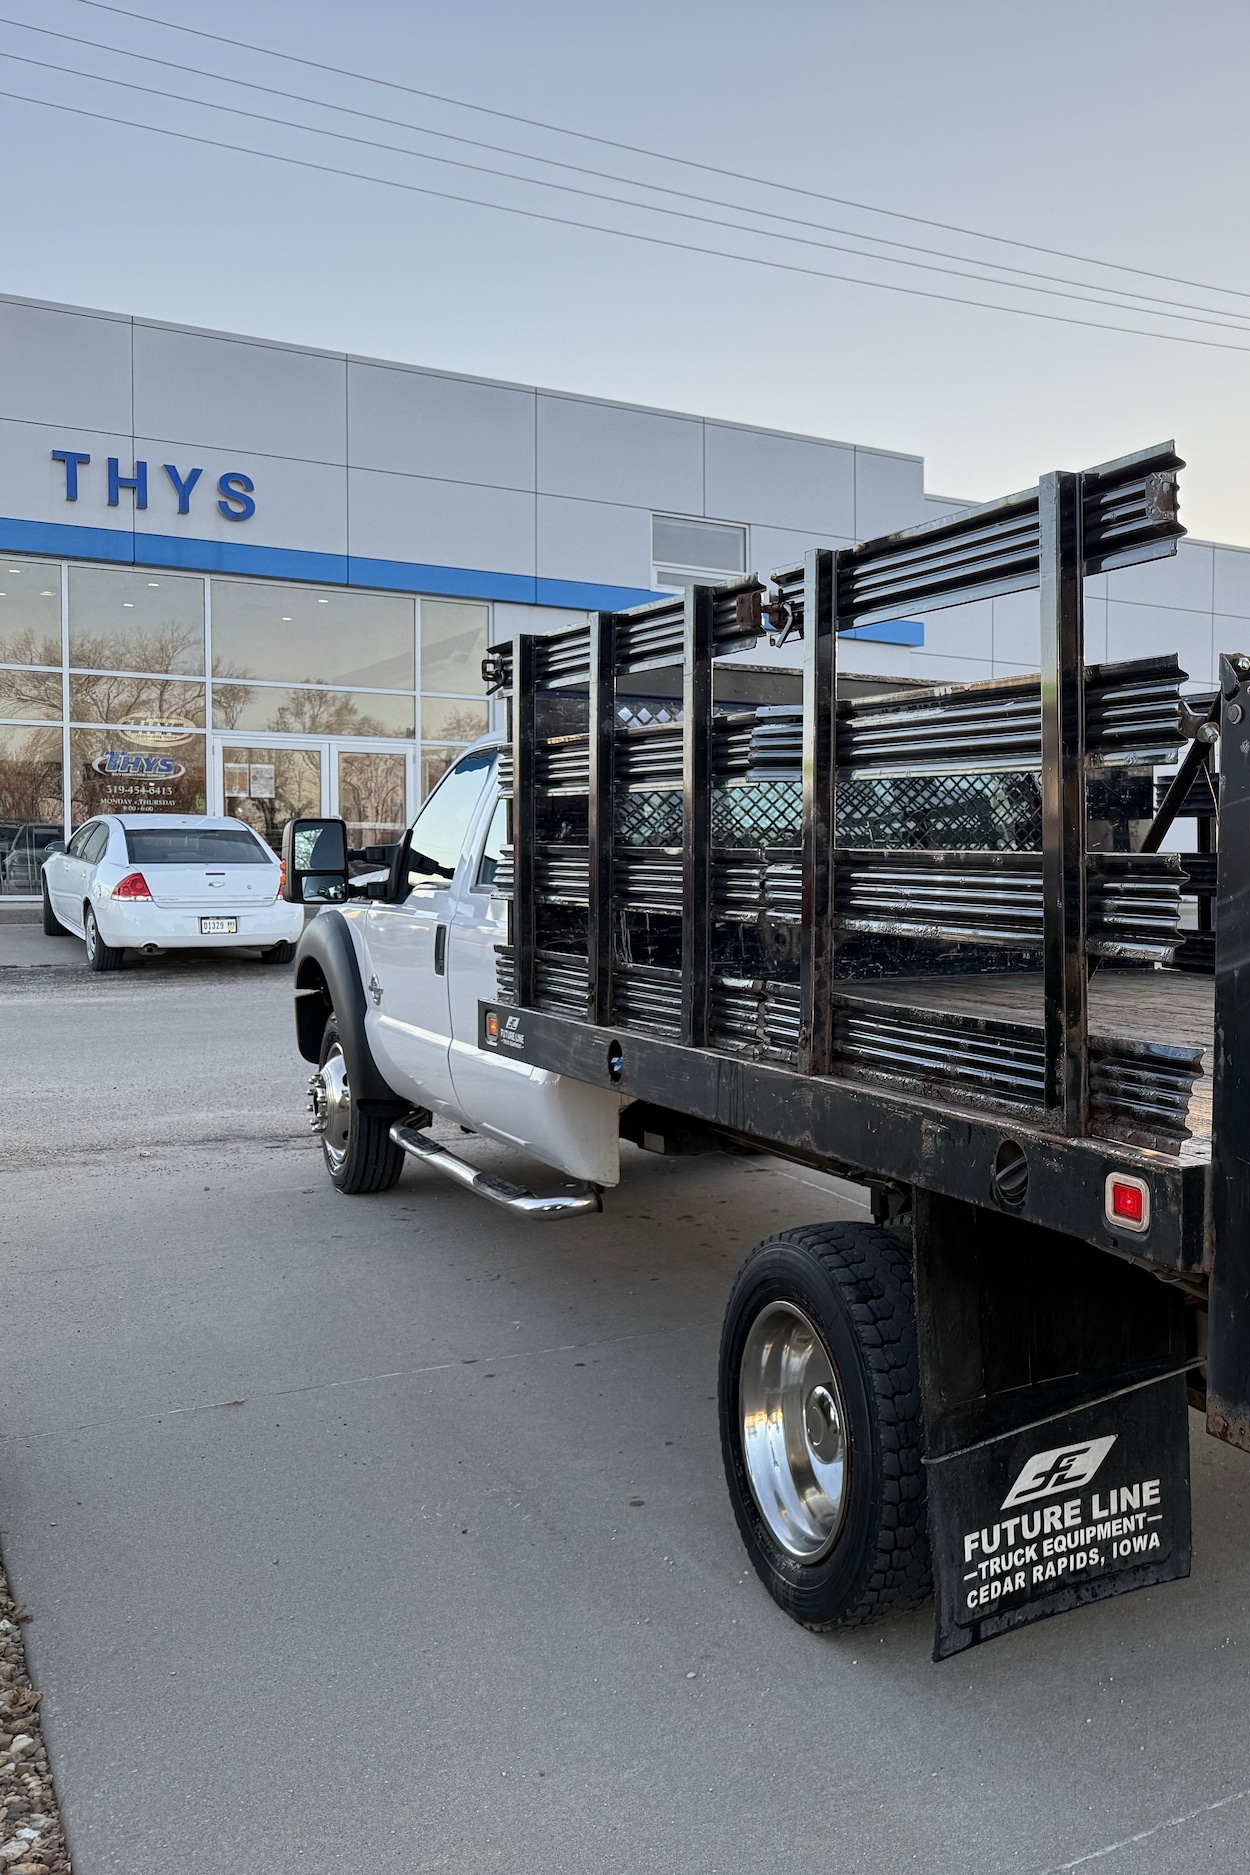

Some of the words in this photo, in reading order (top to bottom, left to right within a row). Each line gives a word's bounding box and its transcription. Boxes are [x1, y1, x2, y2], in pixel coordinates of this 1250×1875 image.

[51, 449, 256, 522] THYS
[104, 750, 175, 774] THYS
[963, 1498, 1082, 1562] FUTURE
[1091, 1479, 1161, 1520] LINE
[966, 1570, 1026, 1609] CEDAR
[1031, 1548, 1106, 1584] RAPIDS,
[1112, 1532, 1161, 1559] IOWA
